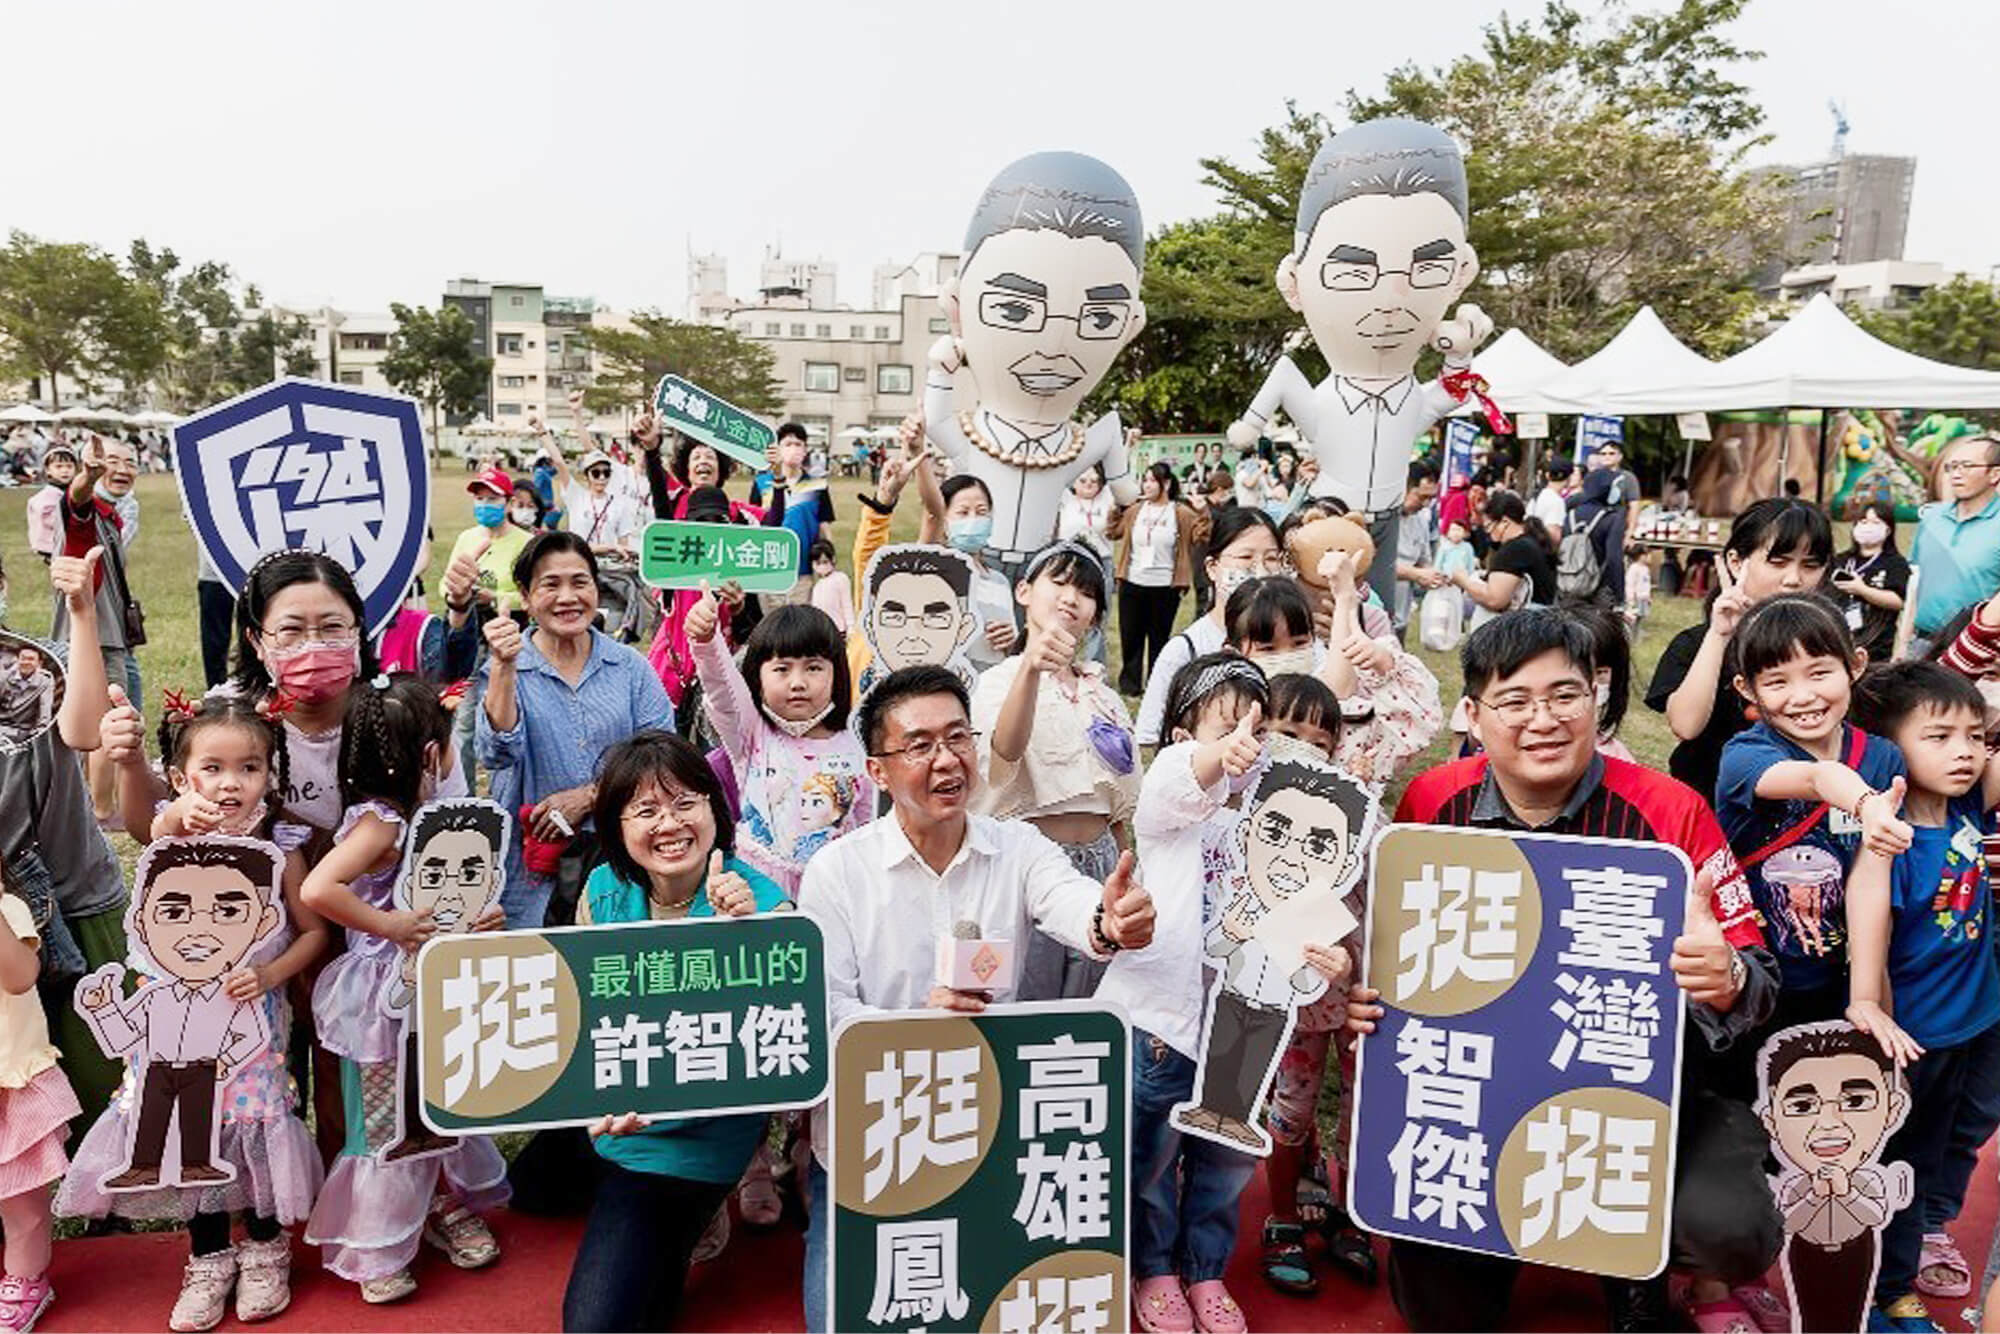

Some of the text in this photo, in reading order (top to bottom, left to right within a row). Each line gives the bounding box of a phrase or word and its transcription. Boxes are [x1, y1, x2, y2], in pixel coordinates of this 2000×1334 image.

[649, 535, 790, 570] 三井小金剛
[589, 941, 808, 998] 最懂鳳山的
[442, 951, 558, 1109] 挺
[589, 1002, 811, 1090] 許智傑
